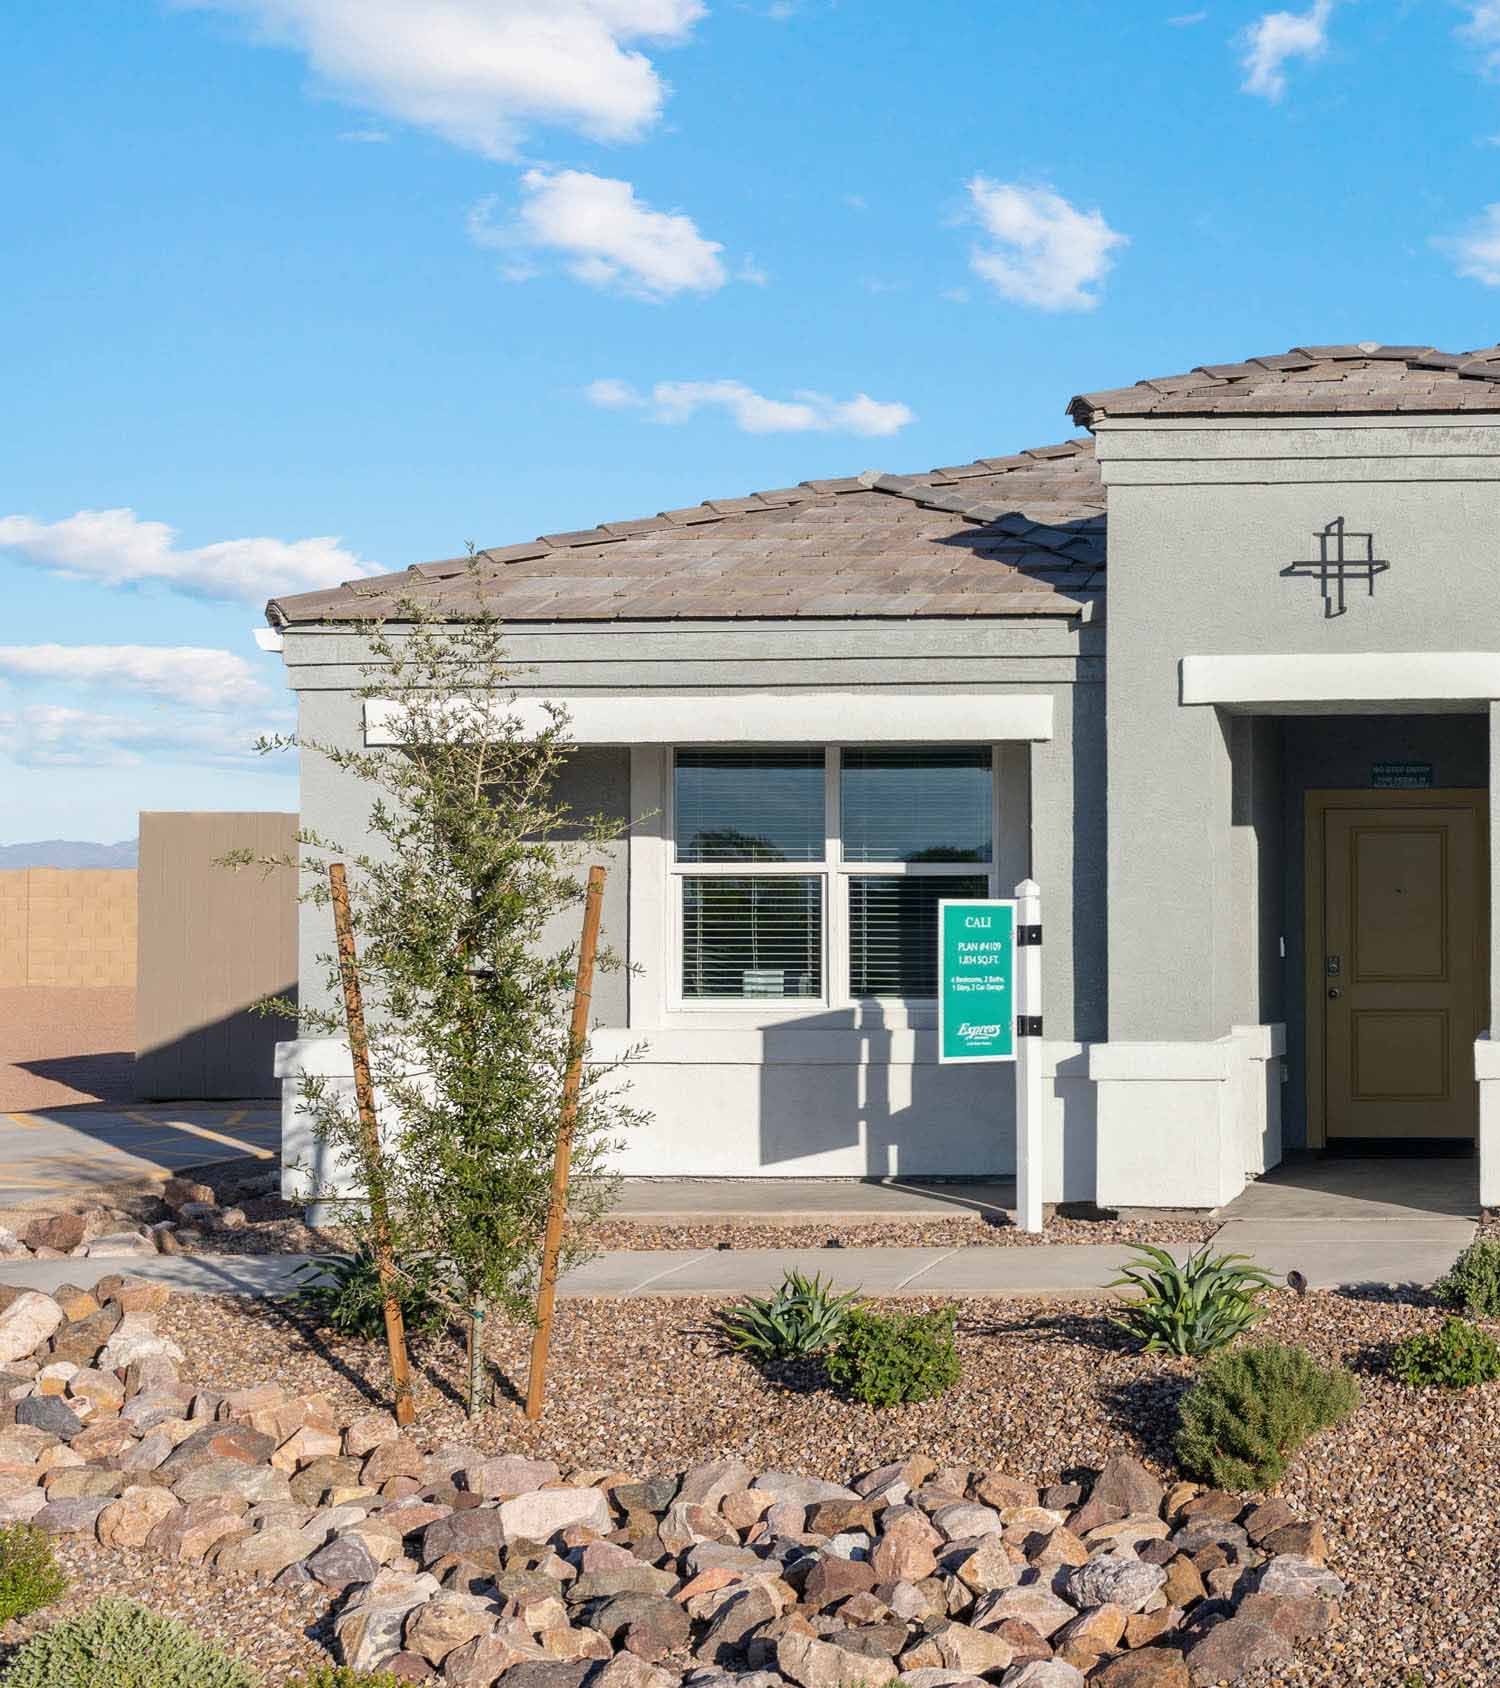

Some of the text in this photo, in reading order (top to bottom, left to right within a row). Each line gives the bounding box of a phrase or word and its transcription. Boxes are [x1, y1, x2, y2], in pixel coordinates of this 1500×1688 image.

[965, 916, 992, 928] CALI
[958, 942, 978, 951] PLAN
[957, 1023, 1001, 1038] Express
